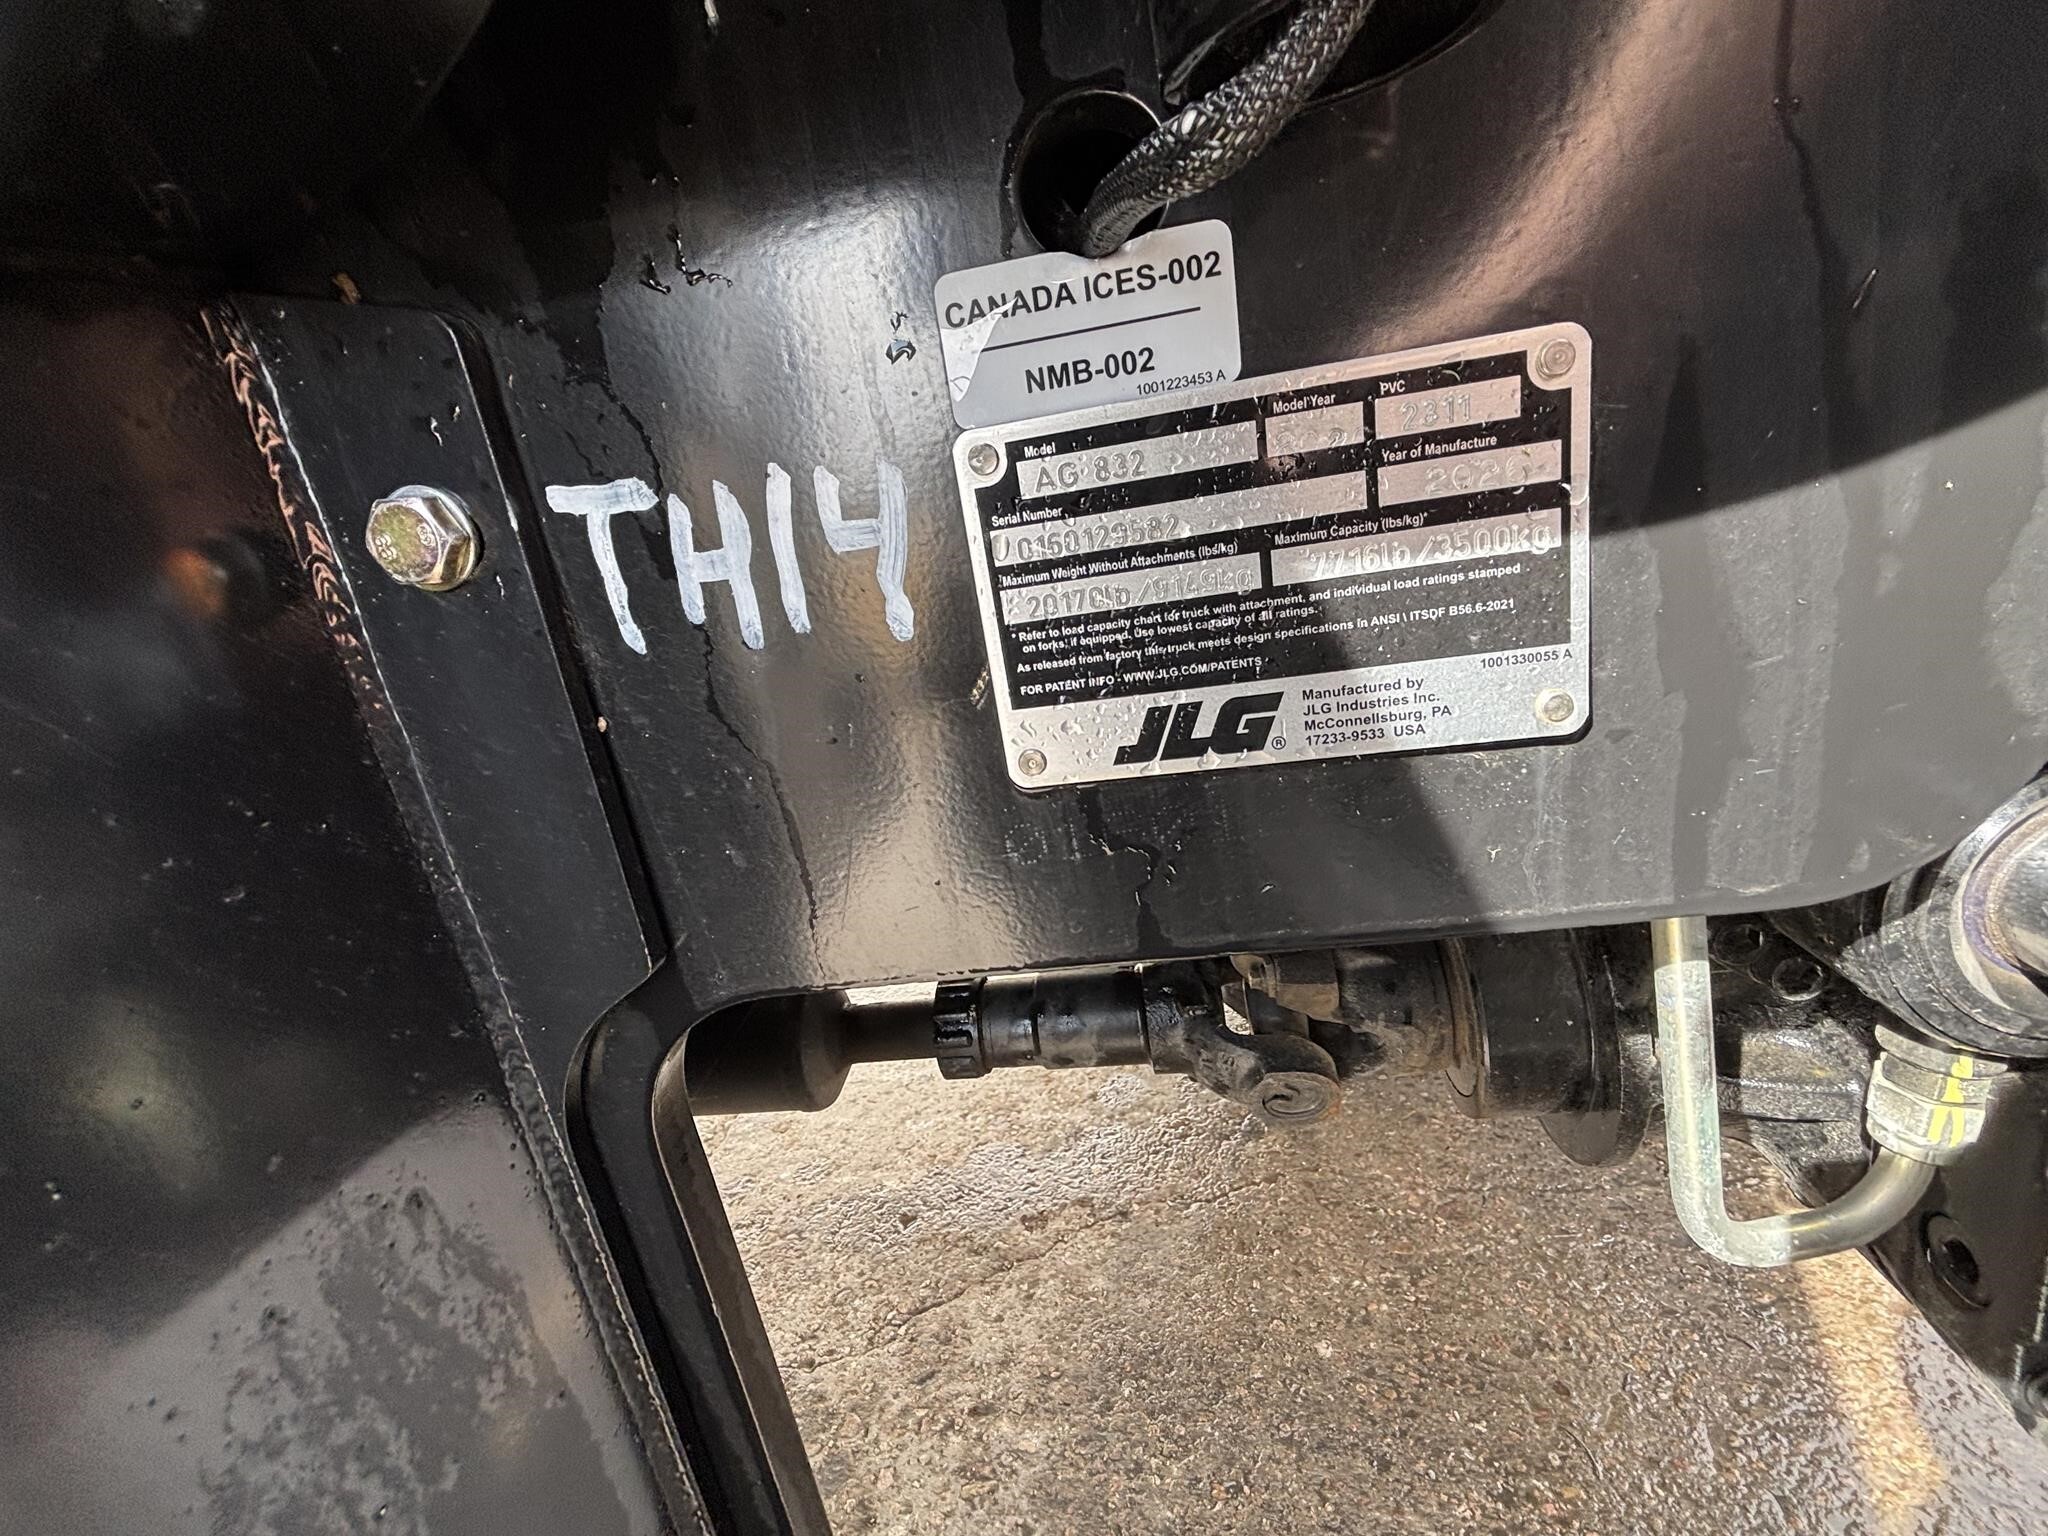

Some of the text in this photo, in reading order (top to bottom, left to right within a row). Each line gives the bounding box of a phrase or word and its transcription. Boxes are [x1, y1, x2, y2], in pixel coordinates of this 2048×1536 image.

[944, 251, 1222, 329] CANADA ICES-002
[1025, 347, 1155, 394] NMB-002
[1136, 369, 1227, 396] 1001223453 A
[1380, 380, 1406, 395] PVC
[1272, 394, 1336, 415] Model Year
[1401, 394, 1473, 432] 2311
[1024, 442, 1056, 459] Model
[1382, 435, 1498, 462] Year of Manufacture
[1035, 449, 1148, 494] AG 832
[991, 505, 1064, 528] Serial Number
[1274, 528, 1328, 547] Maximum
[1330, 520, 1379, 540] Capacity
[545, 459, 915, 657] TH14
[1001, 542, 1239, 588] Maximum Weight Without Attachments (lbs/kg)
[1019, 630, 1047, 643] Refer
[1049, 629, 1060, 639] to
[1061, 624, 1085, 637] load
[1087, 619, 1131, 635] capacity
[1134, 613, 1162, 627] chart
[1164, 611, 1180, 623] for
[1182, 607, 1211, 621] truck
[1213, 603, 1236, 616] with
[1309, 589, 1331, 602] and
[1333, 579, 1391, 598] individual
[1394, 576, 1420, 590] load
[1422, 570, 1465, 589] ratings
[1468, 562, 1521, 581] stamped
[1017, 662, 1031, 673] As
[1033, 656, 1077, 671] released
[1079, 653, 1103, 665] from
[1105, 648, 1143, 663] factory
[1144, 644, 1164, 656] this
[1167, 639, 1196, 654] truck
[1198, 636, 1231, 650] meets
[1234, 631, 1272, 648] design
[1275, 620, 1355, 640] specifications
[1357, 617, 1369, 629] in
[1371, 613, 1401, 627] ANSI
[1410, 608, 1446, 622] ITSDF
[1449, 598, 1515, 616] B56.6-2021
[1023, 643, 1037, 654] on
[1070, 636, 1077, 647] if
[1134, 626, 1154, 639] Use
[1157, 621, 1193, 635] lowest
[1195, 615, 1241, 631] capacity
[1244, 612, 1257, 623] of
[1258, 610, 1273, 622] all
[1480, 648, 1573, 669] 1001330055 A
[1021, 684, 1044, 697] FOR
[1045, 679, 1087, 693] PATENT
[1088, 675, 1115, 688] INFO
[1123, 656, 1263, 683] WWW.JLG.COM/PATENTS
[1302, 677, 1425, 701] Manufactured by
[1303, 692, 1440, 717] JLG Industries Inc.
[1114, 691, 1284, 766] JLG
[1304, 705, 1452, 732] McConnellsburg, PA
[1305, 724, 1426, 747] 17233-9533 USA
